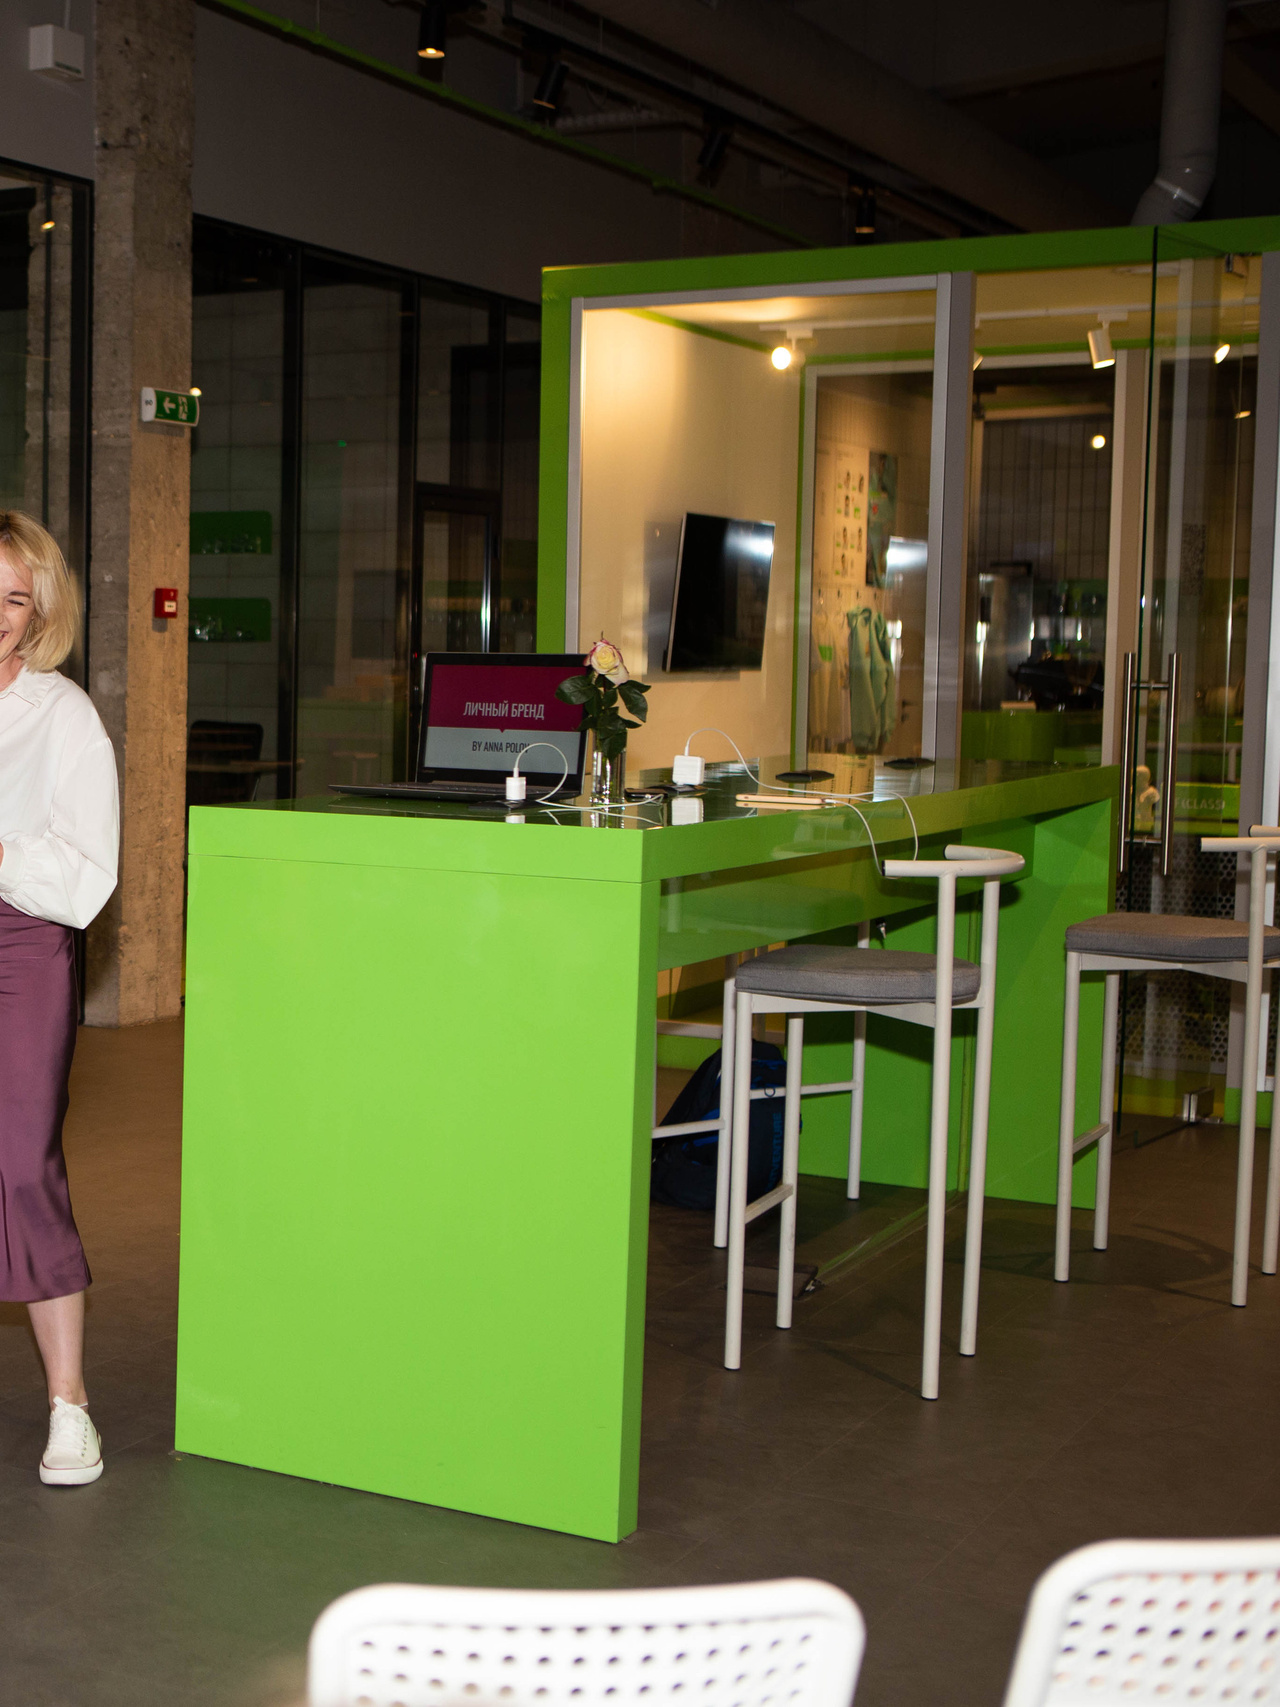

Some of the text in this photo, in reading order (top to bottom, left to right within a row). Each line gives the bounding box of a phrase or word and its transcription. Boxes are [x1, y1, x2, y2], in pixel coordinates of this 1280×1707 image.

[463, 700, 545, 720] ЛИЧНЫЙ БРЕНД
[472, 740, 482, 752] BY
[483, 741, 504, 753] ANNA
